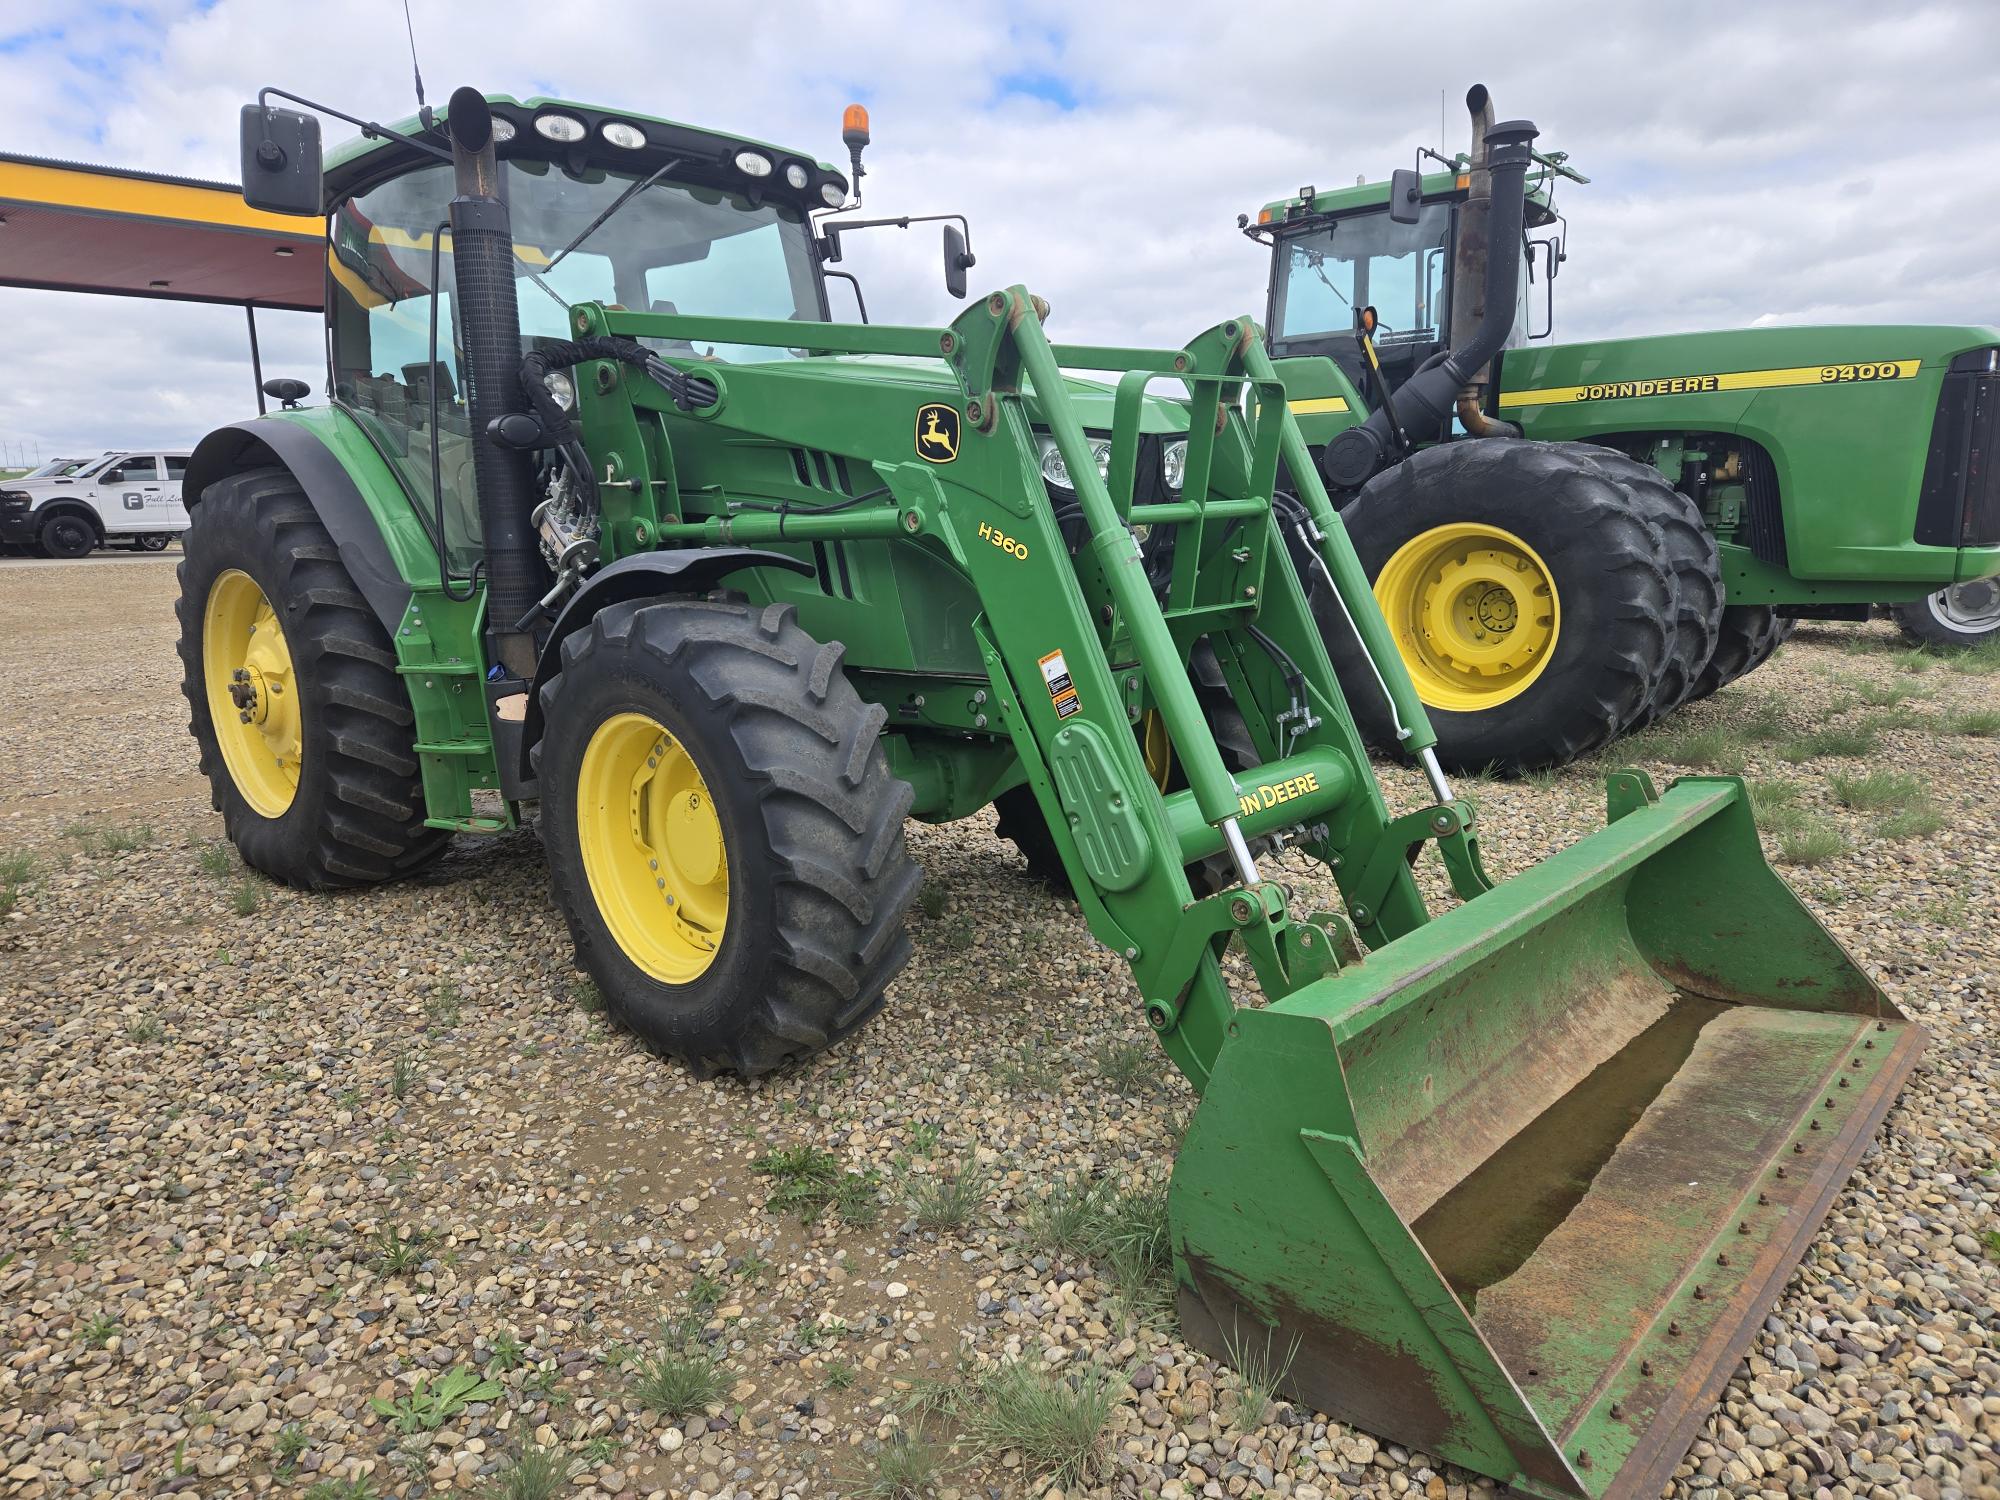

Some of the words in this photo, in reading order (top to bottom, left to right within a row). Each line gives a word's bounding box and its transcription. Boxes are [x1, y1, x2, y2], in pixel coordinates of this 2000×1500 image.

[1821, 363, 1900, 383] 9400
[1576, 384, 1635, 401] JOHN
[1640, 376, 1717, 396] DEERE
[166, 494, 183, 502] Lin
[978, 521, 1028, 560] H360
[1257, 772, 1321, 809] DEERE
